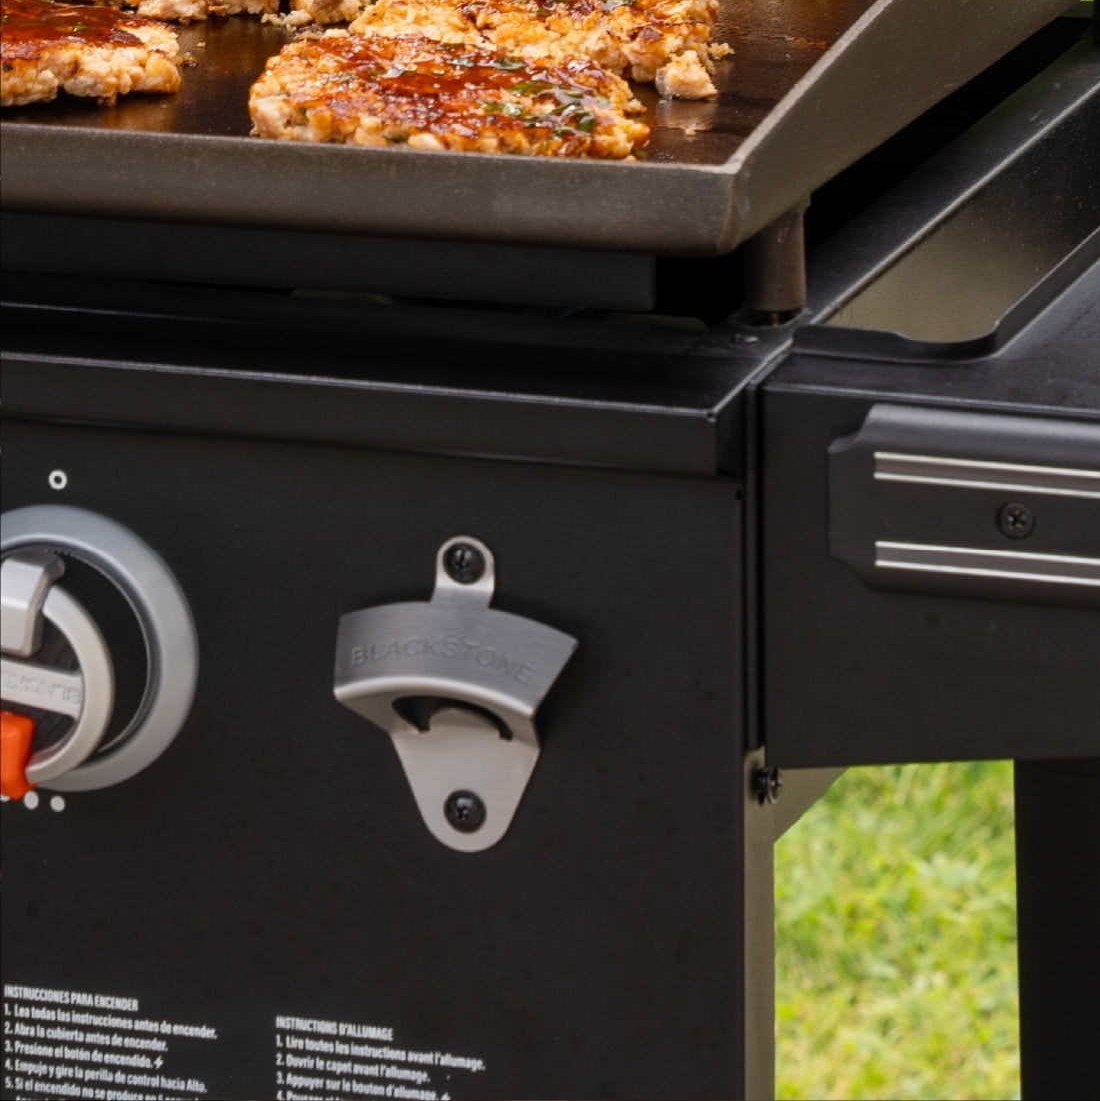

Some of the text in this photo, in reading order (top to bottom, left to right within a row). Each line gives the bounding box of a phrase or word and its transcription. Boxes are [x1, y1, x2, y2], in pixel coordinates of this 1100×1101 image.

[351, 637, 537, 685] BLACKSTONE
[4, 984, 139, 1012] INSTRUCCIONES PARA ENCENDER
[4, 1003, 218, 1039] 1. Lea todas las instrucciones antes de encender.
[4, 1020, 168, 1052] 2. Abra la cubierta antes de encender.
[275, 1015, 394, 1042] INSTRUCTIONS D'ALLUMAGE
[4, 1039, 153, 1069] 3. Presione el botón de encendido.
[276, 1033, 283, 1047] 1.
[286, 1035, 304, 1050] Lire
[305, 1037, 334, 1054] toutes
[335, 1040, 350, 1055] les
[350, 1041, 406, 1062] instructions
[407, 1050, 434, 1065] avant
[5, 1058, 207, 1094] 4. Empuje y gire la perilla de control hacia Alto.
[276, 1052, 284, 1066] 2.
[286, 1053, 315, 1069] Ouvrir
[315, 1056, 325, 1071] le
[326, 1060, 352, 1075] capot
[353, 1063, 379, 1077] avant
[5, 1076, 13, 1089] 5.
[15, 1077, 23, 1091] Si
[25, 1078, 34, 1092] el
[34, 1082, 81, 1097] encendido
[82, 1087, 94, 1099] no
[94, 1089, 105, 1100] se
[276, 1071, 285, 1085] 3.
[286, 1072, 324, 1091] Appuyer
[325, 1079, 341, 1091] sur
[342, 1078, 351, 1092] le
[352, 1079, 385, 1095] bouton
